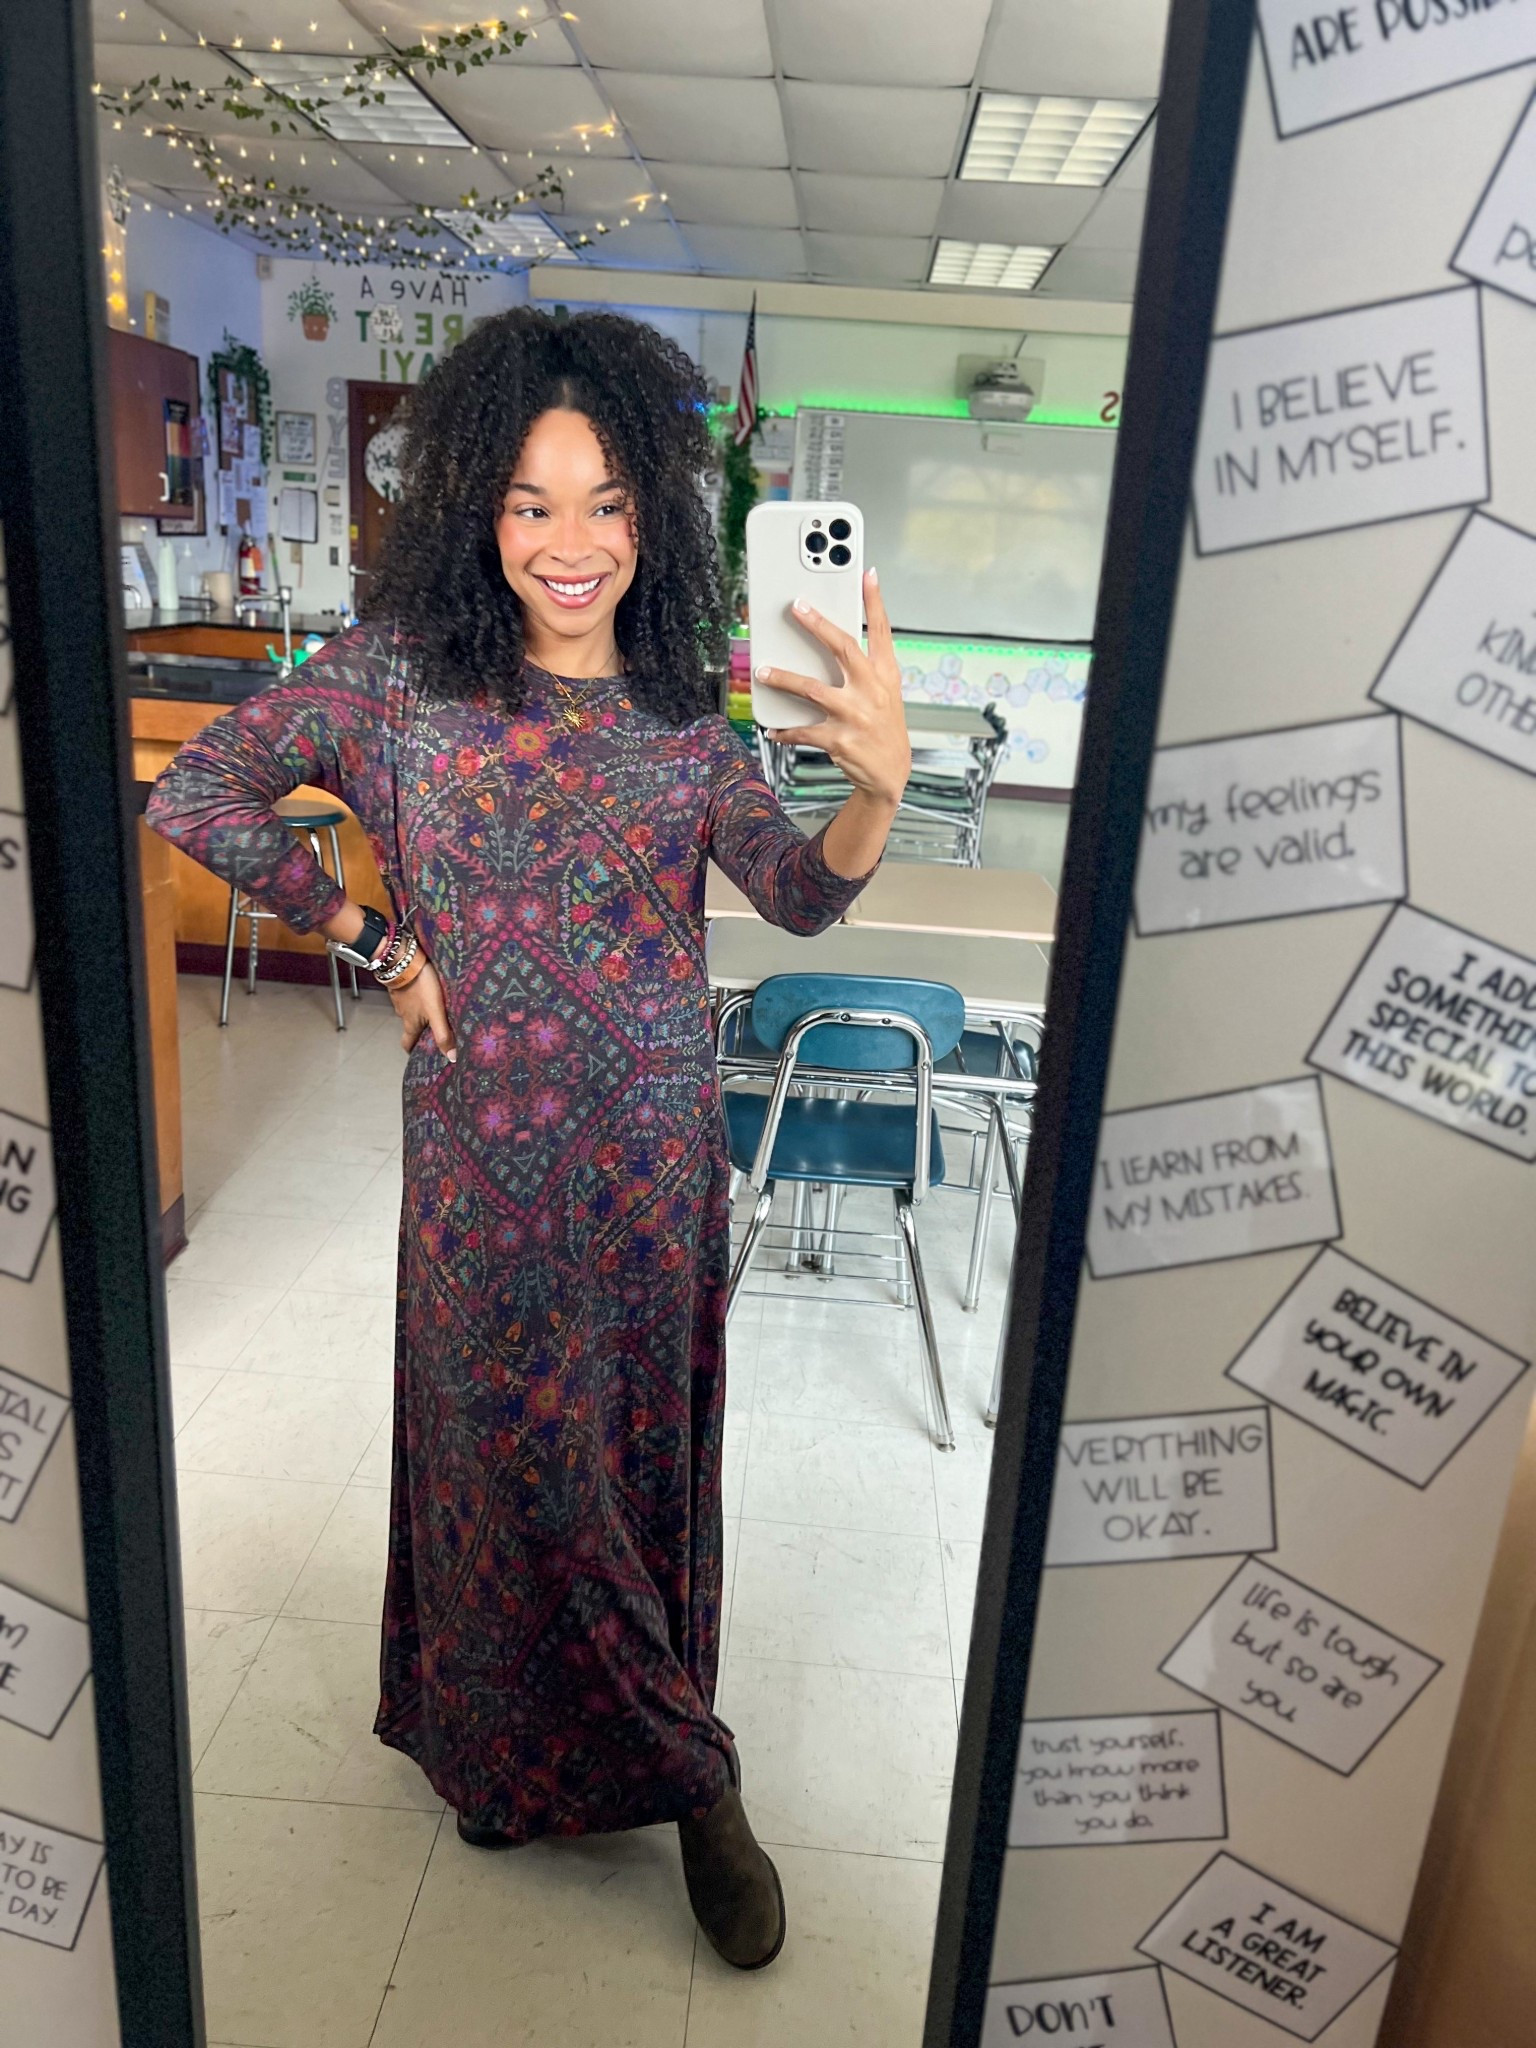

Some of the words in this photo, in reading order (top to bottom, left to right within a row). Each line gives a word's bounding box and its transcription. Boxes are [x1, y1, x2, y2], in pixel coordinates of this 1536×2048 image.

[1291, 8, 1362, 70] ARE
[1231, 391, 1242, 432] I
[1257, 350, 1438, 428] BELIEVE
[1214, 446, 1258, 496] IN
[1277, 409, 1466, 485] MYSELF.
[1226, 770, 1381, 822] feelings
[1179, 845, 1242, 878] are
[1255, 821, 1355, 869] valid.
[1451, 952, 1479, 982] I
[1367, 1000, 1497, 1079] SPECIAL
[1342, 1029, 1416, 1080] THIS
[1421, 1065, 1527, 1135] WORLD.
[1100, 1160, 1113, 1190] I
[1121, 1147, 1203, 1186] LEARN
[1212, 1131, 1299, 1171] FROM
[1104, 1196, 1151, 1231] MY
[1332, 1287, 1444, 1362] BELIEVE
[1437, 1348, 1477, 1382] IN
[1303, 1369, 1394, 1435] MAGIC.
[1381, 1368, 1456, 1418] OWN
[1060, 1424, 1263, 1468] VERYTHING
[1082, 1473, 1169, 1504] WILL
[1183, 1468, 1223, 1499] BE
[1103, 1509, 1211, 1541] OKAY.
[1242, 1582, 1291, 1620] life
[1294, 1609, 1320, 1637] is
[1323, 1625, 1399, 1687] tough
[1231, 1620, 1283, 1666] but
[1284, 1656, 1318, 1683] so
[1321, 1676, 1364, 1708] are
[1240, 1680, 1297, 1723] you
[1030, 1734, 1083, 1754] trust
[1089, 1728, 1183, 1755] yourself.
[1020, 1765, 1062, 1784] you
[1068, 1763, 1134, 1778] know
[1140, 1758, 1200, 1775] more
[1034, 1789, 1083, 1807] than
[1089, 1790, 1131, 1808] you
[1138, 1782, 1191, 1801] think
[1075, 1817, 1118, 1835] you
[30, 1841, 54, 1865] IS
[2, 1862, 35, 1890] TO
[41, 1876, 68, 1901] BE
[1211, 1917, 1236, 1939] A
[1241, 1931, 1328, 1984] GREAT
[1250, 1902, 1276, 1926] I
[1274, 1919, 1328, 1954] AM
[1181, 1929, 1308, 2011] LISTENER.
